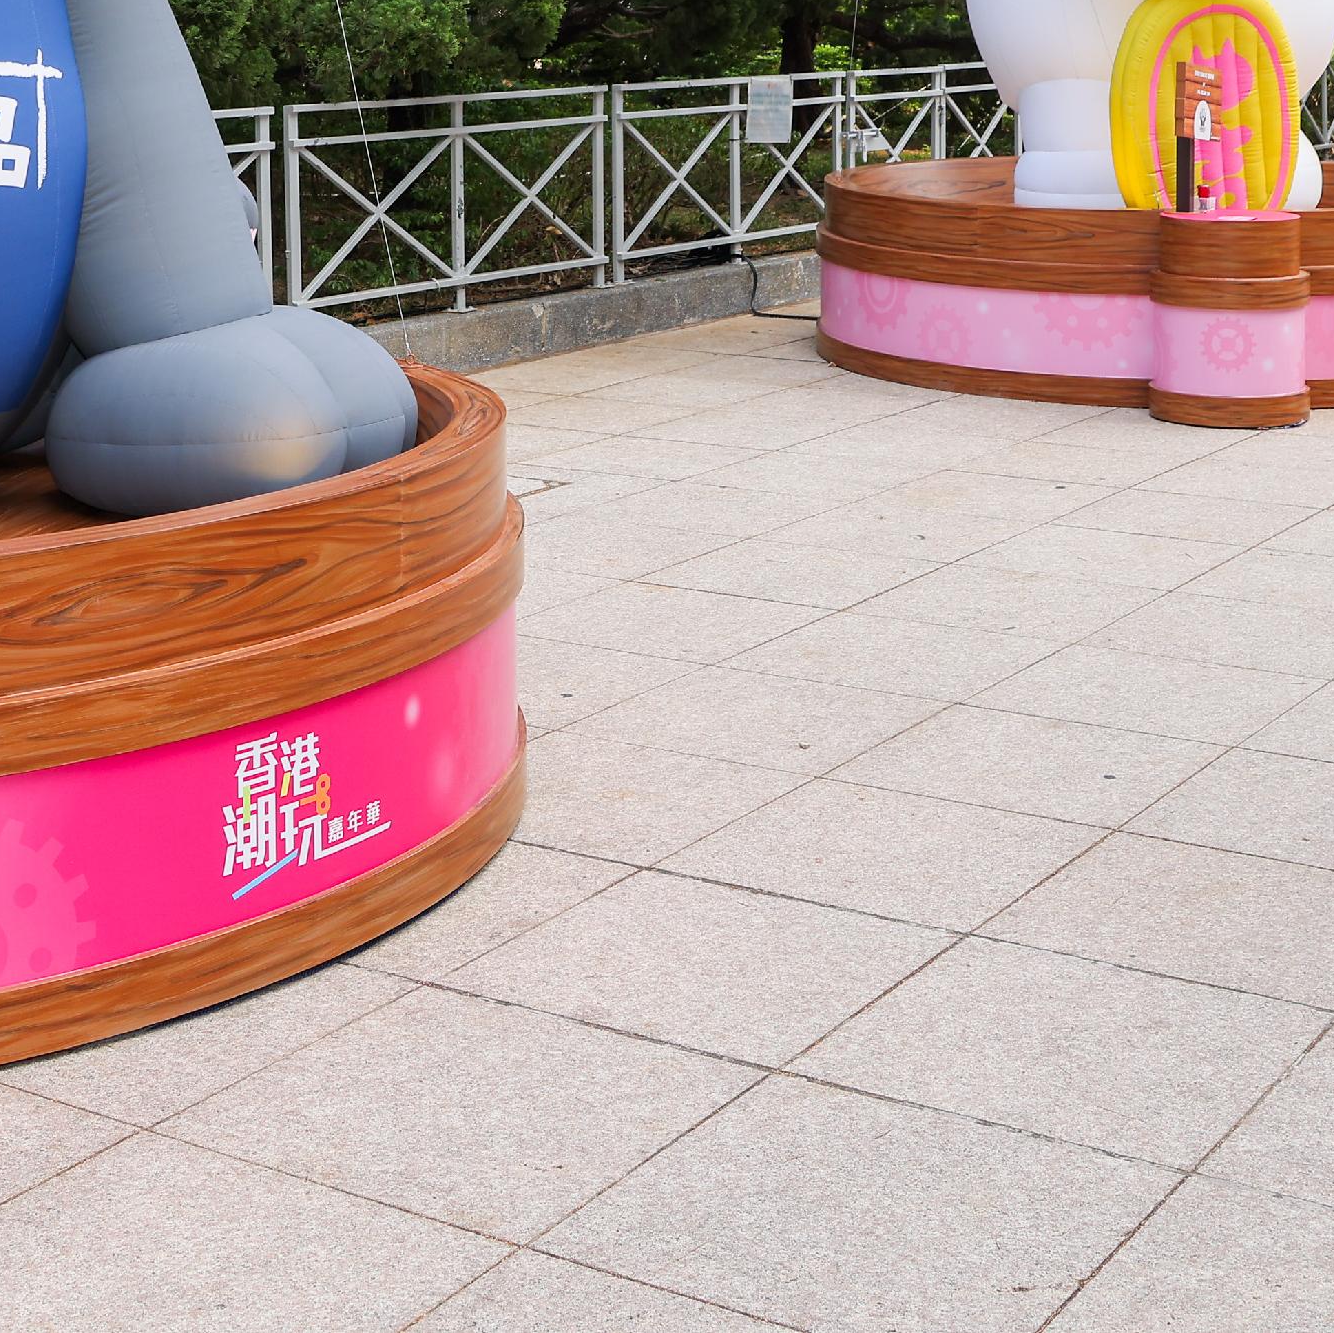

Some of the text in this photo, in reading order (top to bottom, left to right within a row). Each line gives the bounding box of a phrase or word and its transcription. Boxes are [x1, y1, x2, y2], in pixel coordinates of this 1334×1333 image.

[234, 731, 320, 798] 香港
[222, 790, 381, 877] 潮玩 嘉年華
